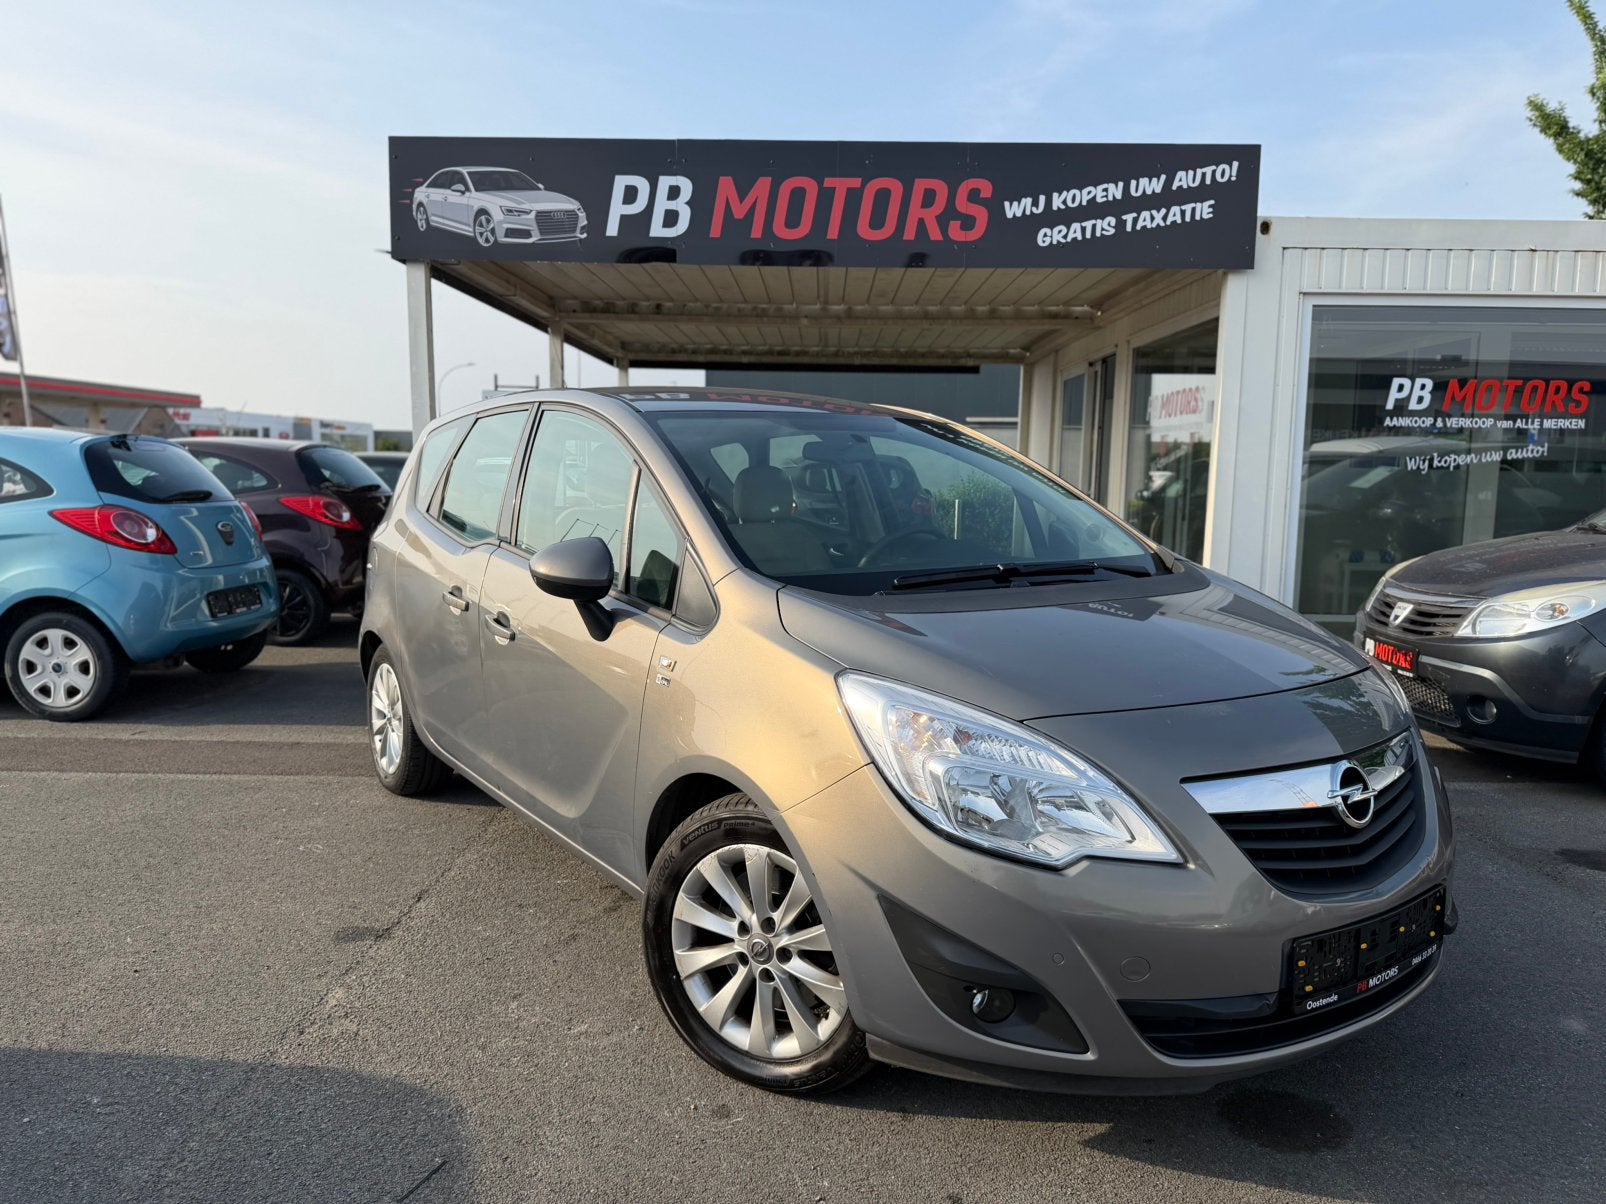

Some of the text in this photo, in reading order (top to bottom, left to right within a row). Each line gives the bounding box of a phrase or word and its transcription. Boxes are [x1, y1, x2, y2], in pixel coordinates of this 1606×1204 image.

[1003, 161, 1239, 219] WIJ KOPEN UW AUTO!
[605, 174, 993, 242] PB MOTORS
[1036, 200, 1216, 247] GRATIS TAXATIE
[1159, 386, 1200, 419] MOTORS
[1385, 377, 1591, 414] PB MOTORS
[1384, 416, 1586, 430] AANKOOP & VERKOOP van ALLE MERKEN
[1405, 442, 1549, 474] Wij kopen uw auto!
[1368, 966, 1399, 988] MOTORS
[1306, 993, 1338, 1010] Oostende
